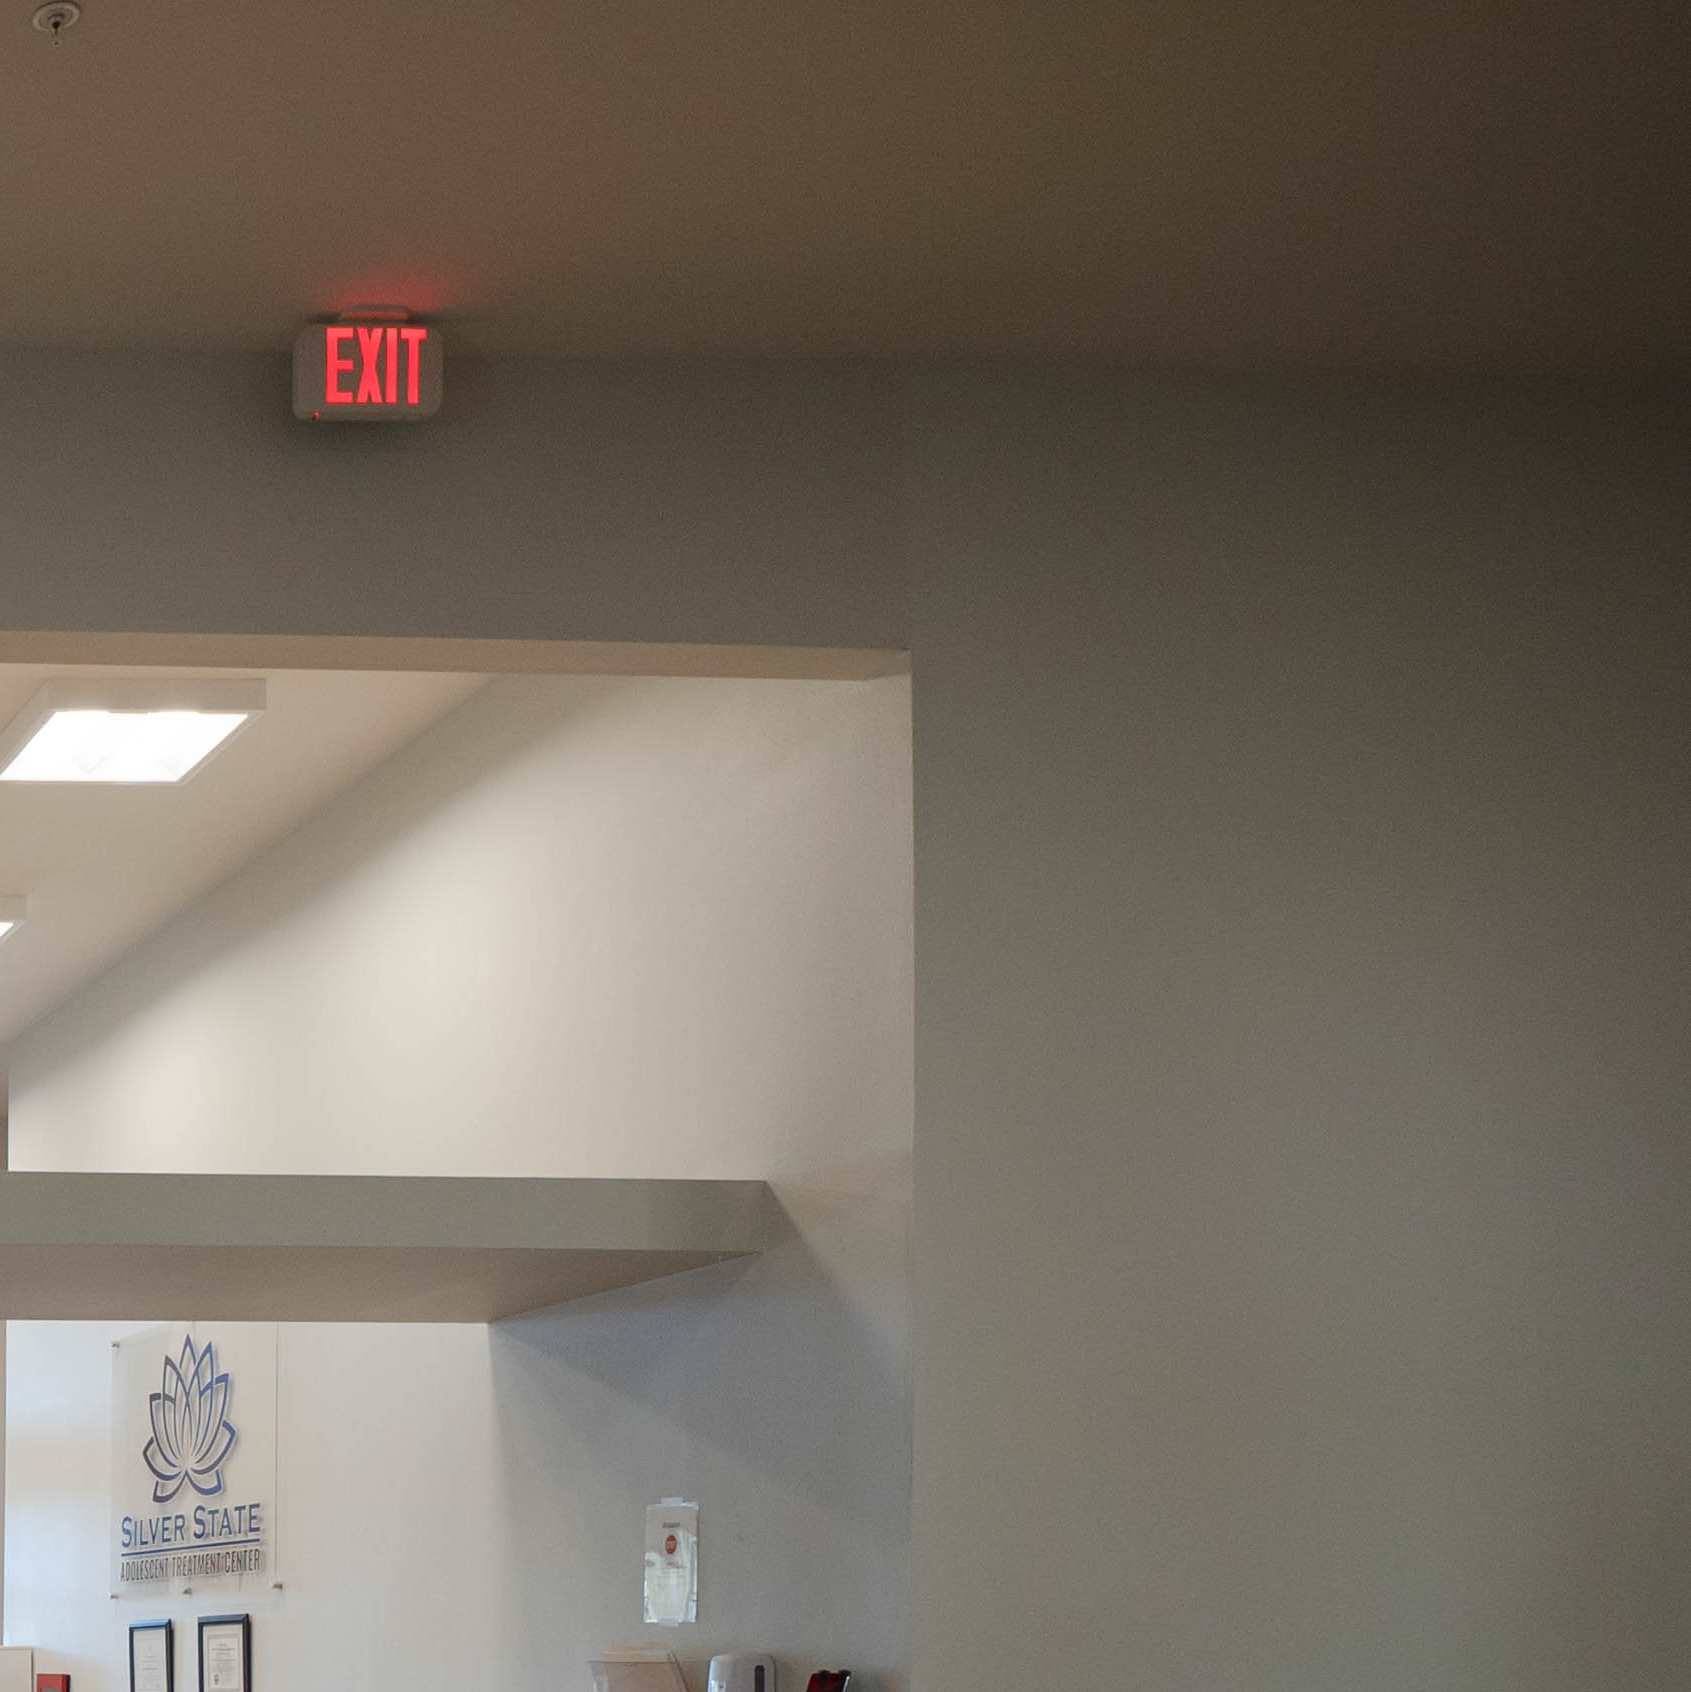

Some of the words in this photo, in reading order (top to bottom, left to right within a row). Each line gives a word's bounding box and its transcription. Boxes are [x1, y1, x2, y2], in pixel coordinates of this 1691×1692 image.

[325, 327, 427, 405] EXIT
[121, 1514, 186, 1548] SILVER
[193, 1503, 260, 1540] STATE
[121, 1557, 169, 1582] ADOLESCENT
[172, 1552, 221, 1577] TREATMENT
[224, 1548, 260, 1573] CENTER
